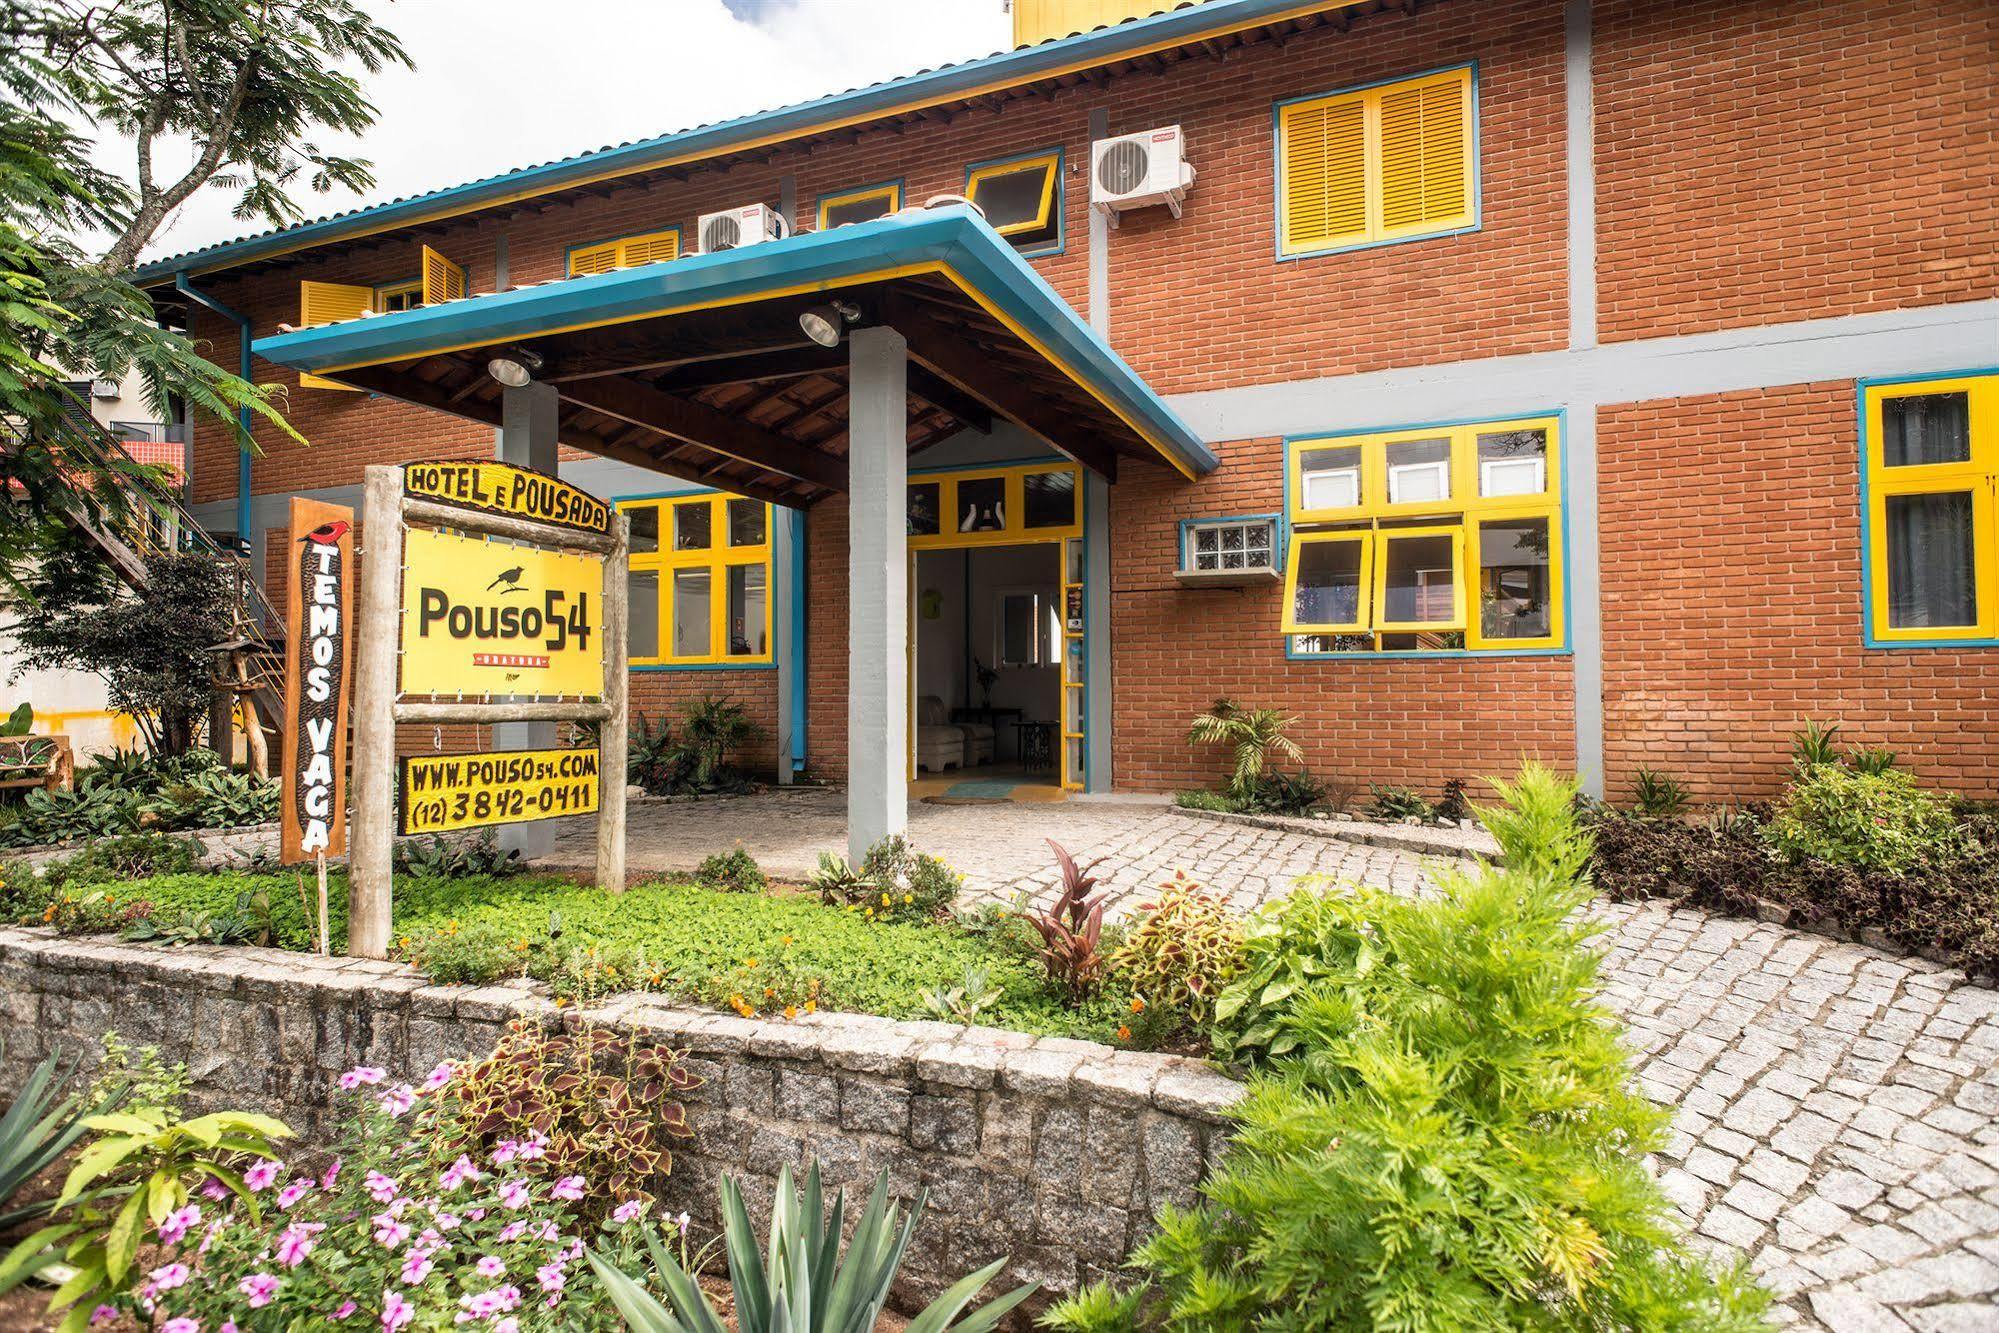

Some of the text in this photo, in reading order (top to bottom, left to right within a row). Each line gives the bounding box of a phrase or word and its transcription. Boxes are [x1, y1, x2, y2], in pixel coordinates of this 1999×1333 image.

[411, 467, 606, 528] HOTEL E POUSADA
[419, 587, 591, 651] Pouso54
[301, 543, 339, 853] TEMOS VAGA
[412, 754, 598, 792] WWW.POUSO54.COM
[412, 783, 590, 828] (12) 3842-0411
